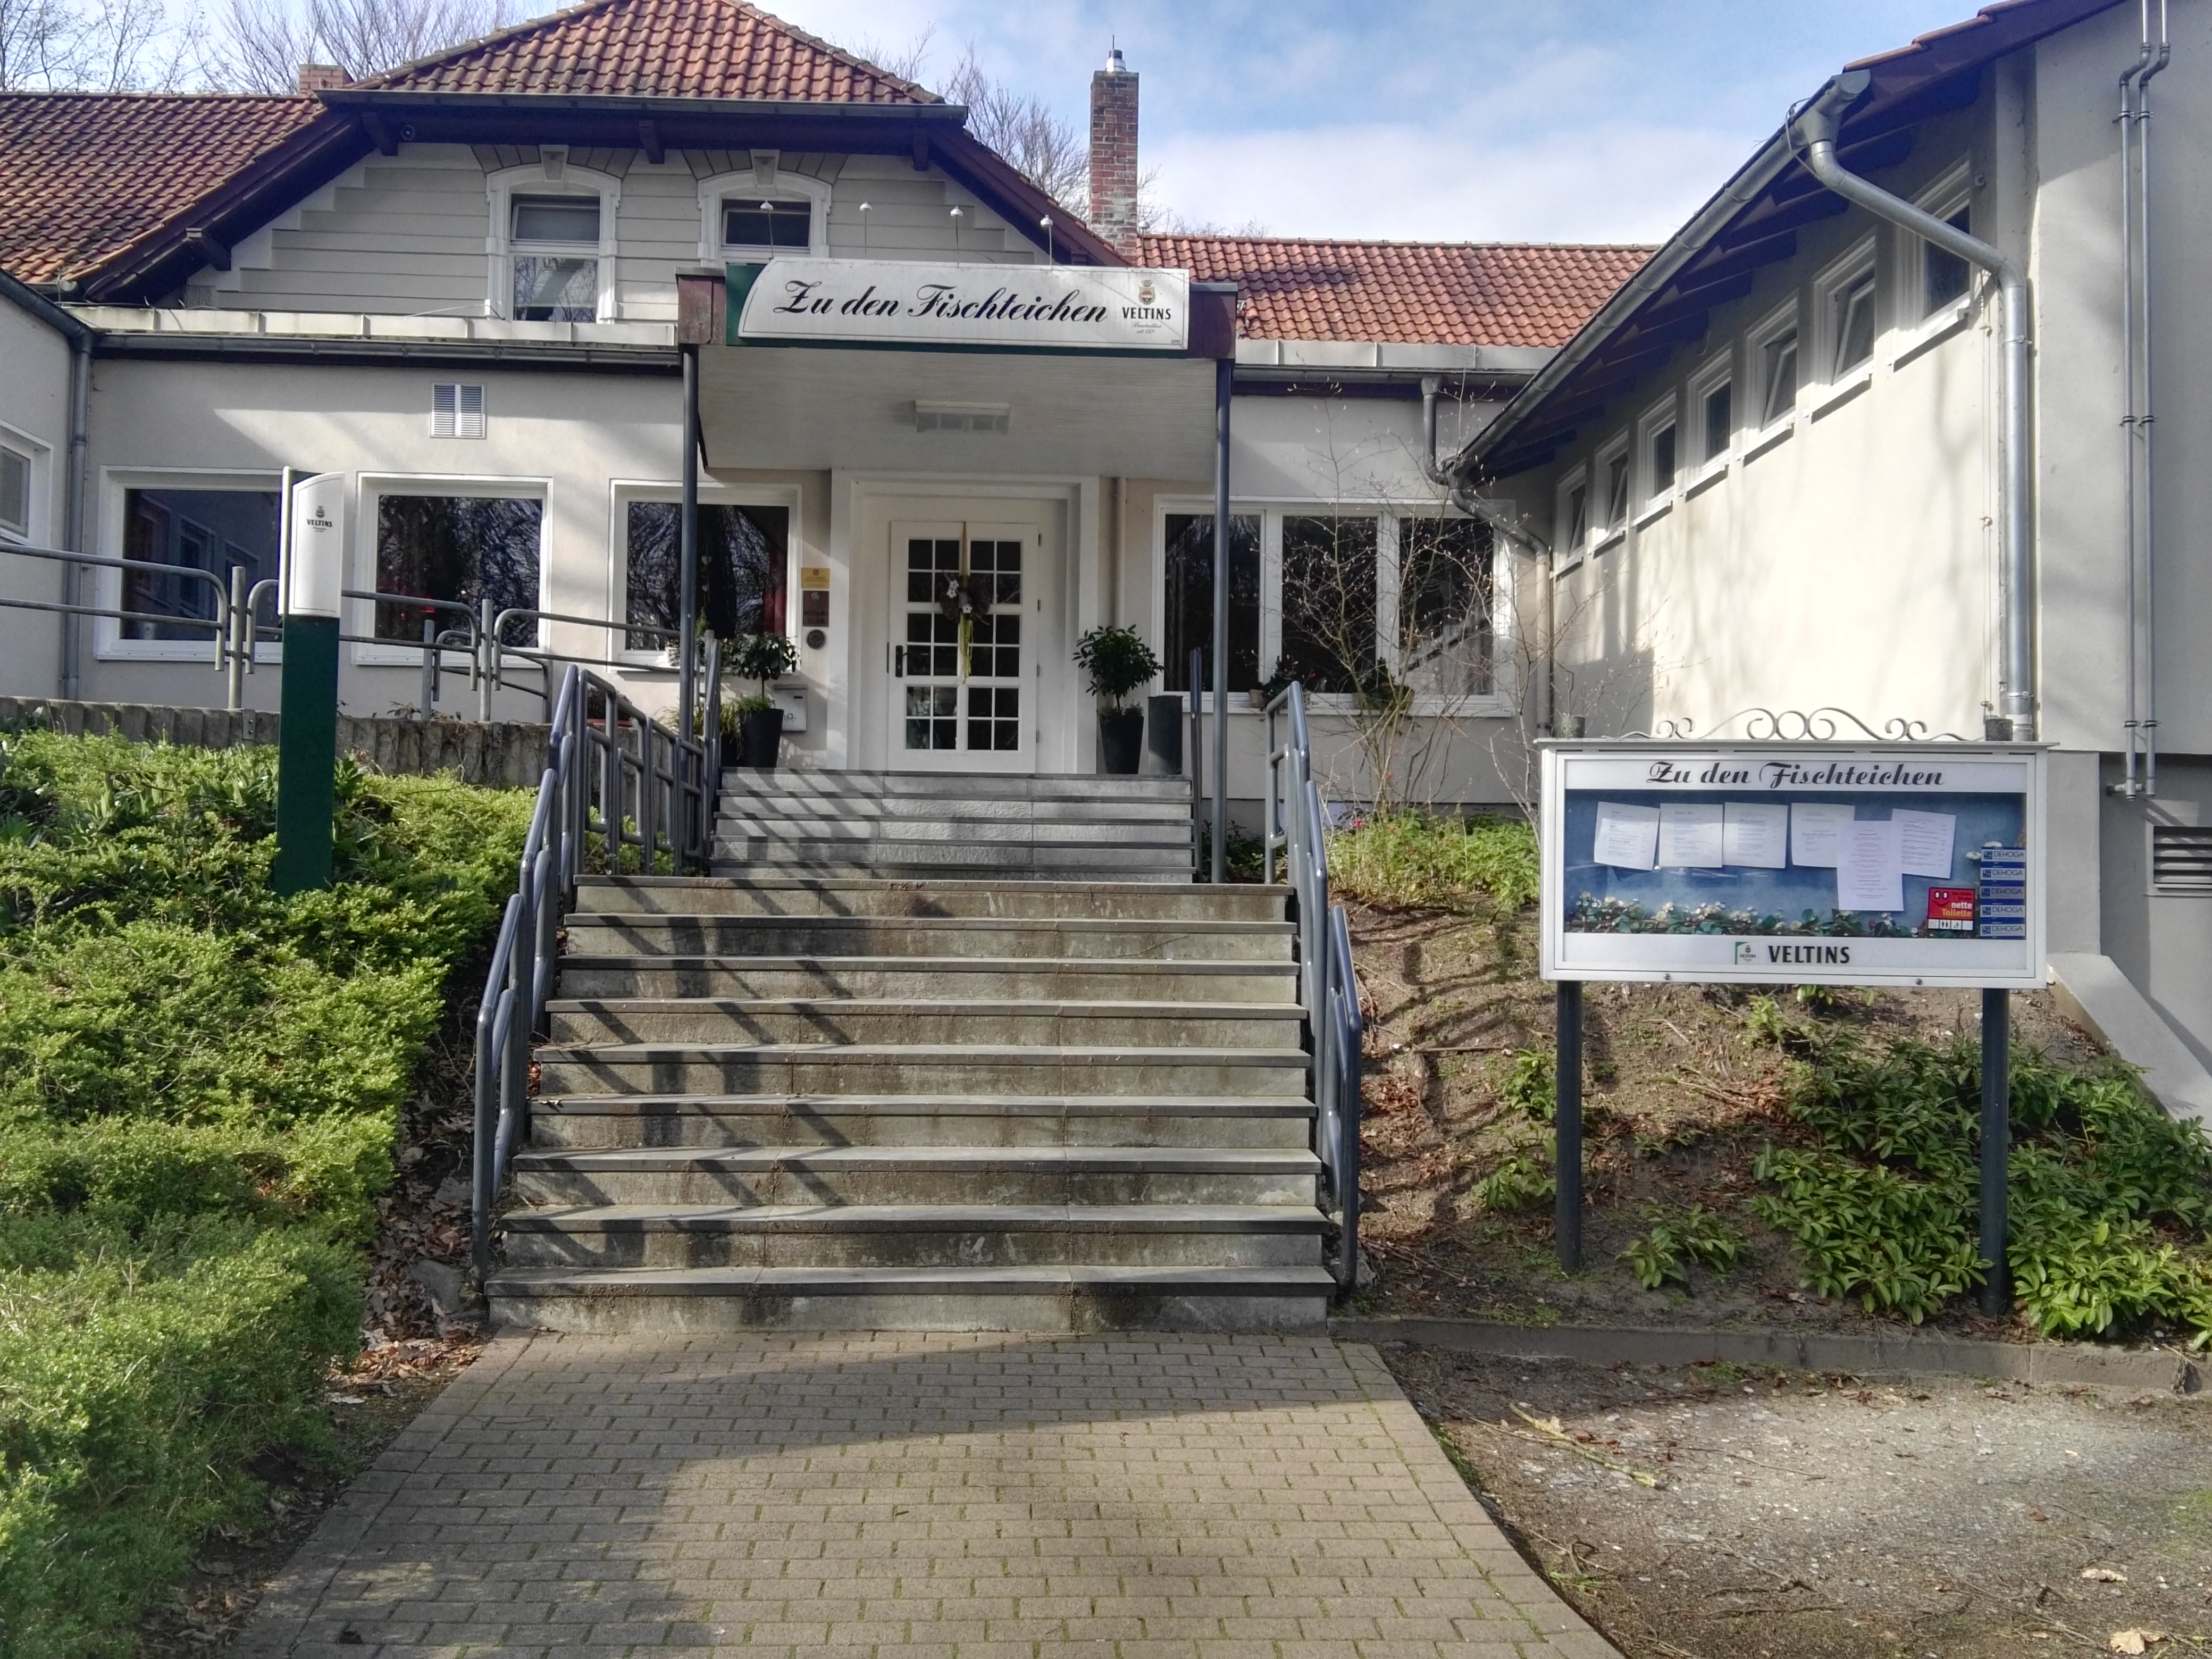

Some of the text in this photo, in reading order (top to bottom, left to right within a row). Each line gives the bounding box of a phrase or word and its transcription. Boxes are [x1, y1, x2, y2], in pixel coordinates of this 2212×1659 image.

[773, 280, 1108, 322] Zu den Fischteichen
[1122, 307, 1171, 320] VELTINS
[307, 518, 332, 527] VELTINS
[1646, 761, 1945, 789] Zu den Fischteichen
[1941, 908, 1972, 917] Toilette
[1768, 945, 1850, 964] VELTINS
